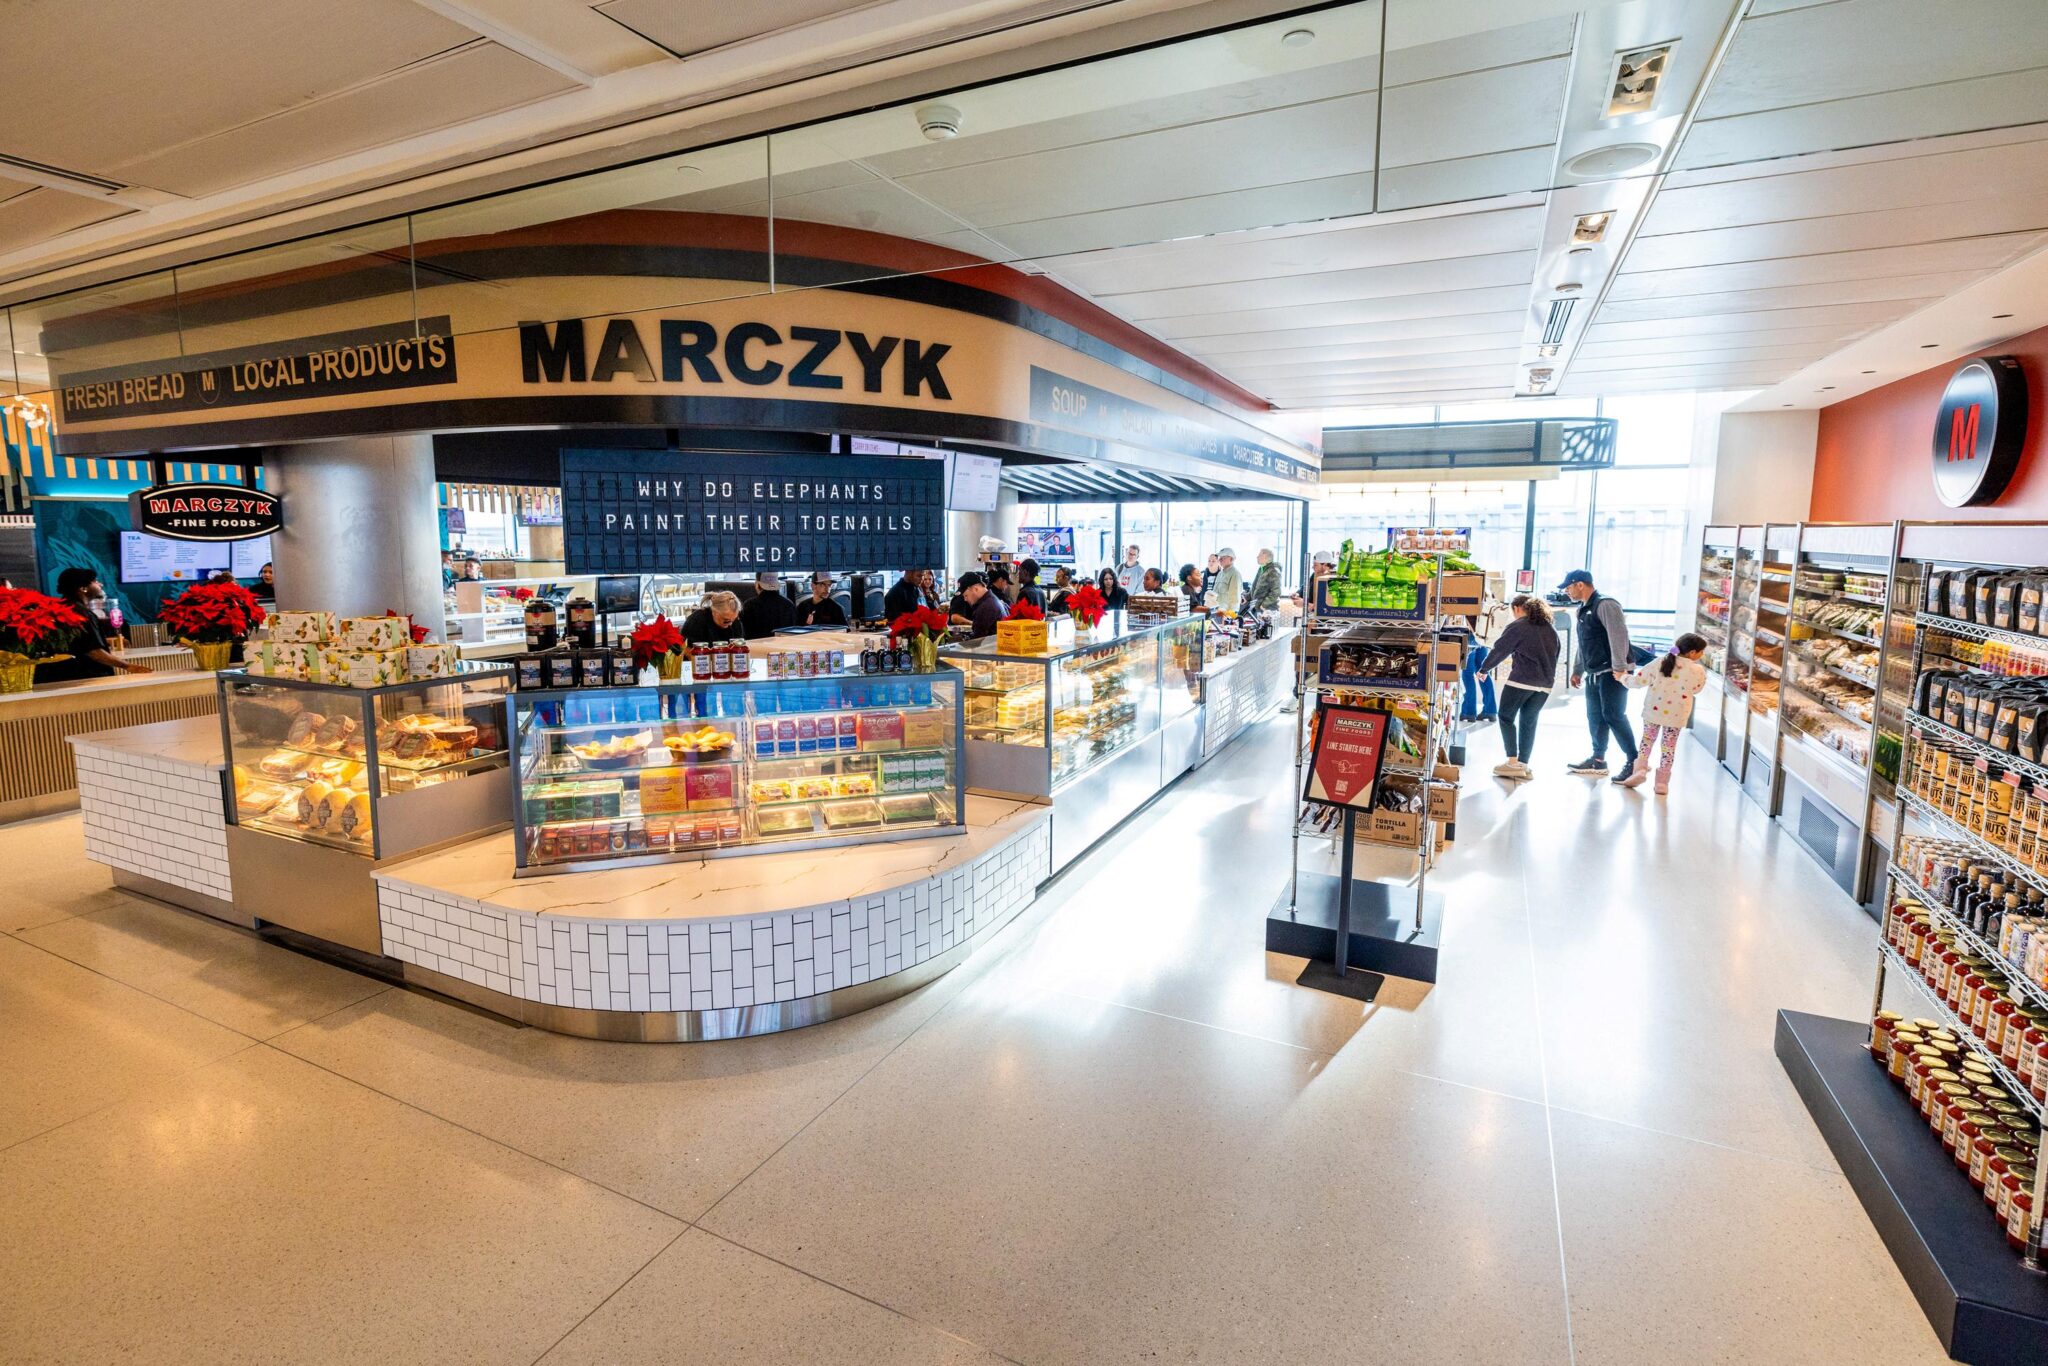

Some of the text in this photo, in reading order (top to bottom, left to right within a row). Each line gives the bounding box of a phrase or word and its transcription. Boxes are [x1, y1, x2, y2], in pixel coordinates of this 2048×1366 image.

[518, 318, 952, 400] MARCZYK
[65, 382, 118, 412] FRESH
[124, 371, 185, 405] BREAD
[231, 356, 304, 393] LOCAL
[308, 334, 446, 382] PRODUCTS
[1052, 385, 1087, 418] SOUP
[1947, 403, 1980, 463] M
[637, 480, 884, 500] WHY DO ELEPHANTS
[150, 497, 273, 517] MARCZYK
[605, 513, 913, 531] PAINT THEIR TOENAILS
[738, 546, 797, 563] RED?
[1337, 719, 1373, 729] MARCZYK
[1327, 741, 1373, 755] LINE STARTS HERE
[1375, 818, 1406, 827] TORTILLA
